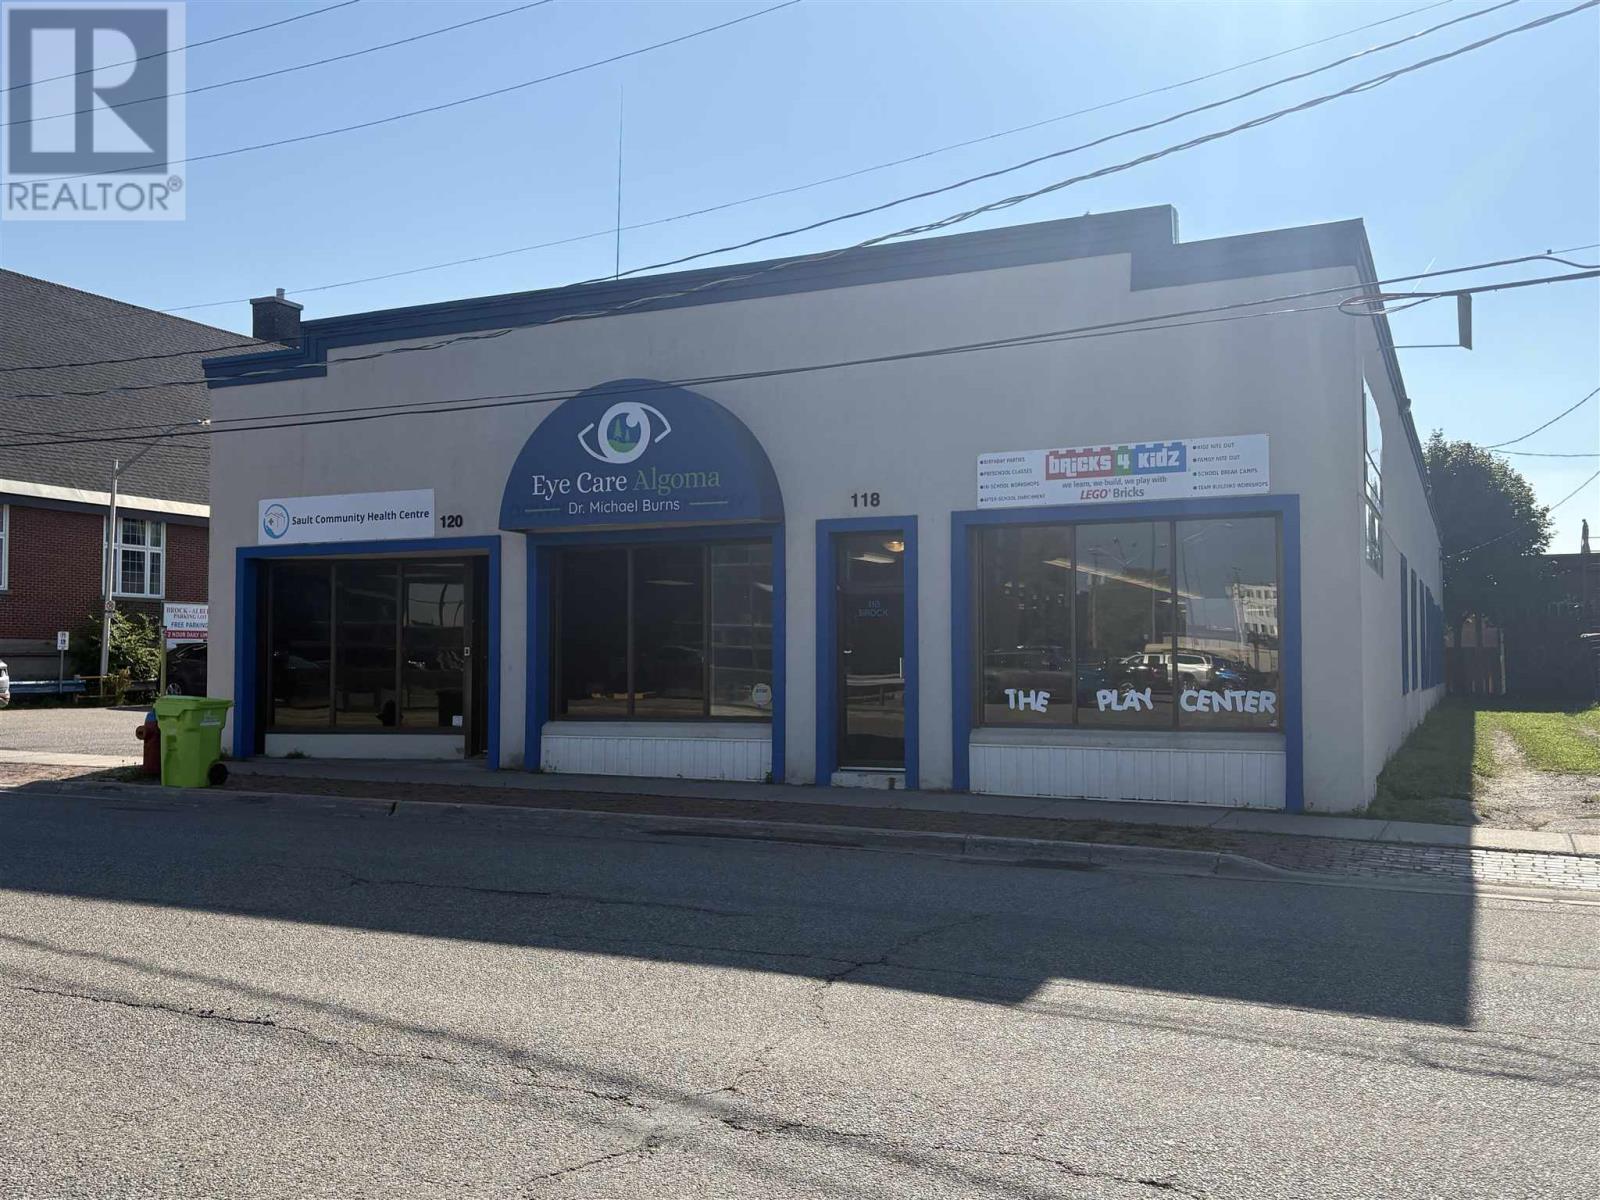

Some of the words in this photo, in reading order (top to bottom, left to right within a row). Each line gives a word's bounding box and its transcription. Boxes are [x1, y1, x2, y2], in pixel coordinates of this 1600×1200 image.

[1117, 453, 1130, 469] 4
[531, 475, 570, 500] Eye
[577, 472, 627, 494] Care
[633, 467, 720, 495] Algoma
[1136, 476, 1151, 486] play
[1151, 476, 1167, 484] with
[851, 492, 880, 507] 118
[1113, 487, 1145, 499] Bricks
[568, 502, 586, 515] Dr.
[590, 499, 638, 514] Michael
[642, 498, 680, 513] Burns
[292, 515, 313, 526] Sault
[315, 512, 365, 525] Community
[367, 510, 397, 522] Health
[399, 509, 430, 520] Centre
[439, 514, 463, 529] 120
[1004, 688, 1050, 713] THE
[1096, 687, 1154, 713] PLAY
[1180, 689, 1277, 714] CENTER
